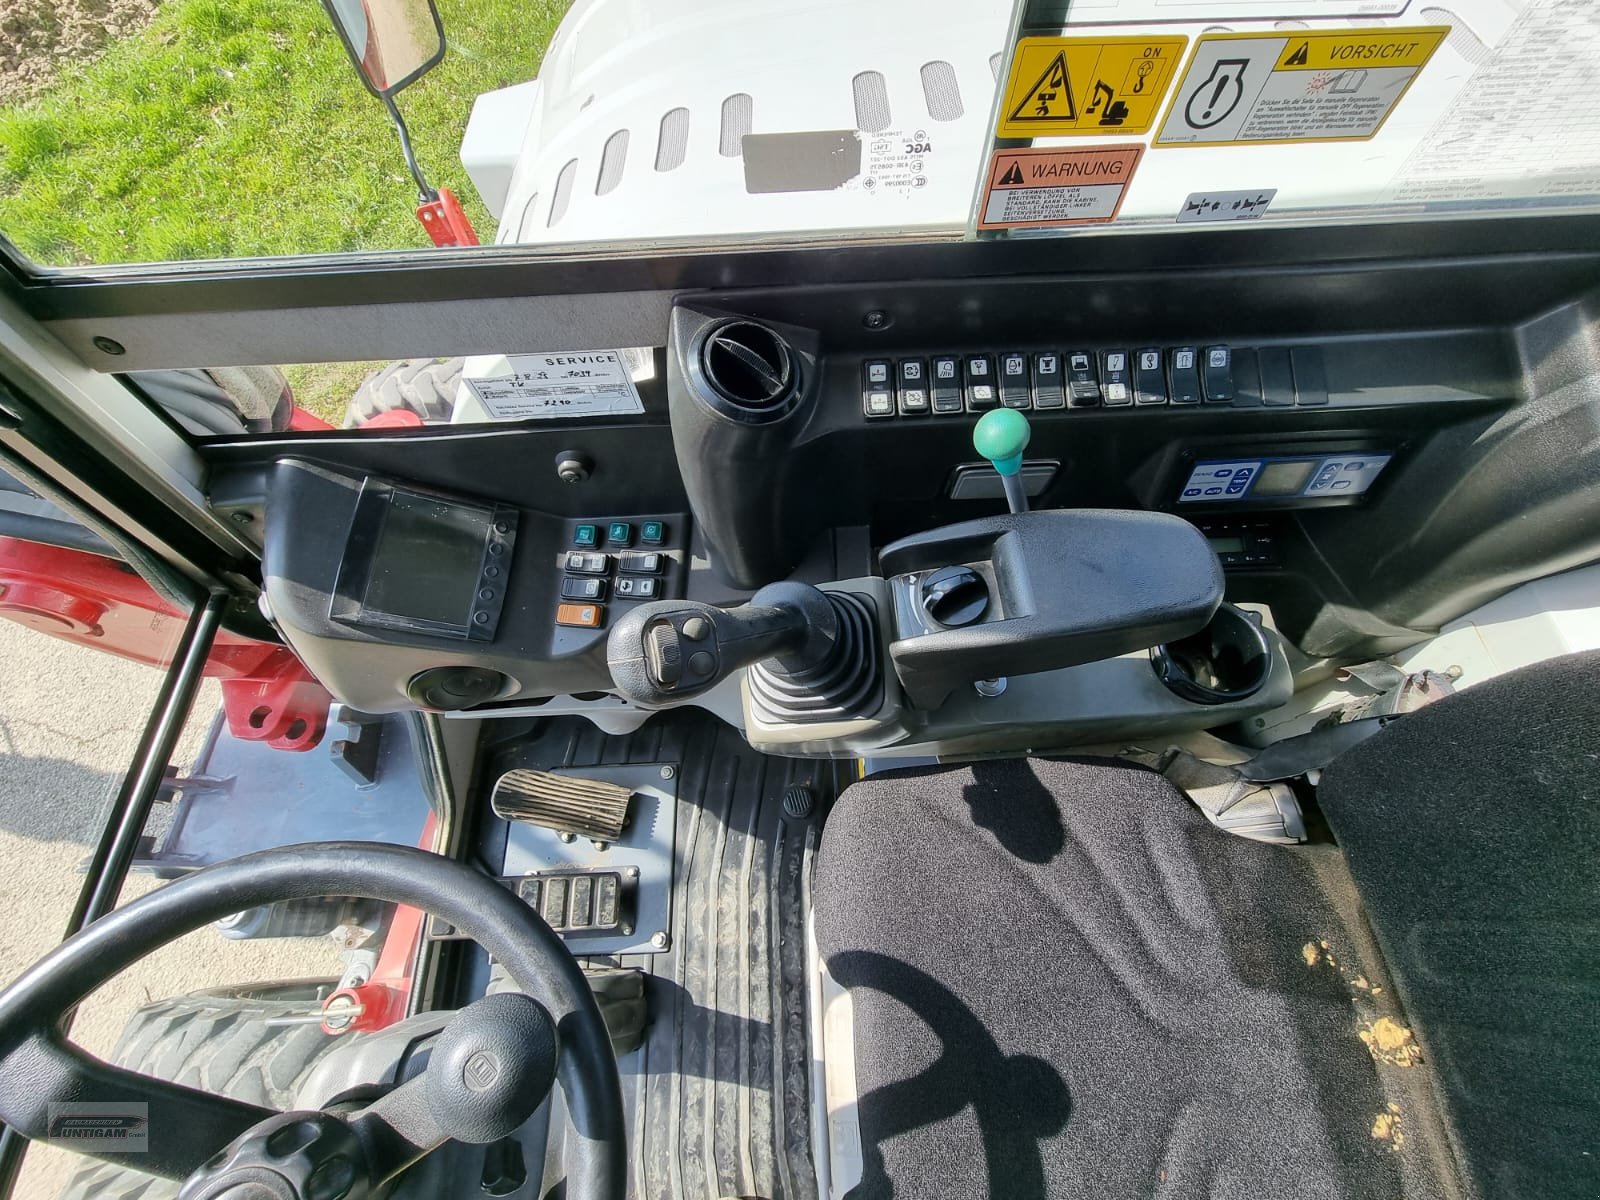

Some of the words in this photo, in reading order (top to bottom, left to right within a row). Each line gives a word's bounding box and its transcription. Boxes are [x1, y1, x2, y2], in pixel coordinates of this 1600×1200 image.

[1142, 47, 1161, 62] ON
[1330, 43, 1419, 60] VORSICHT
[1032, 161, 1124, 178] WARNUNG
[545, 355, 617, 366] SERVICE
